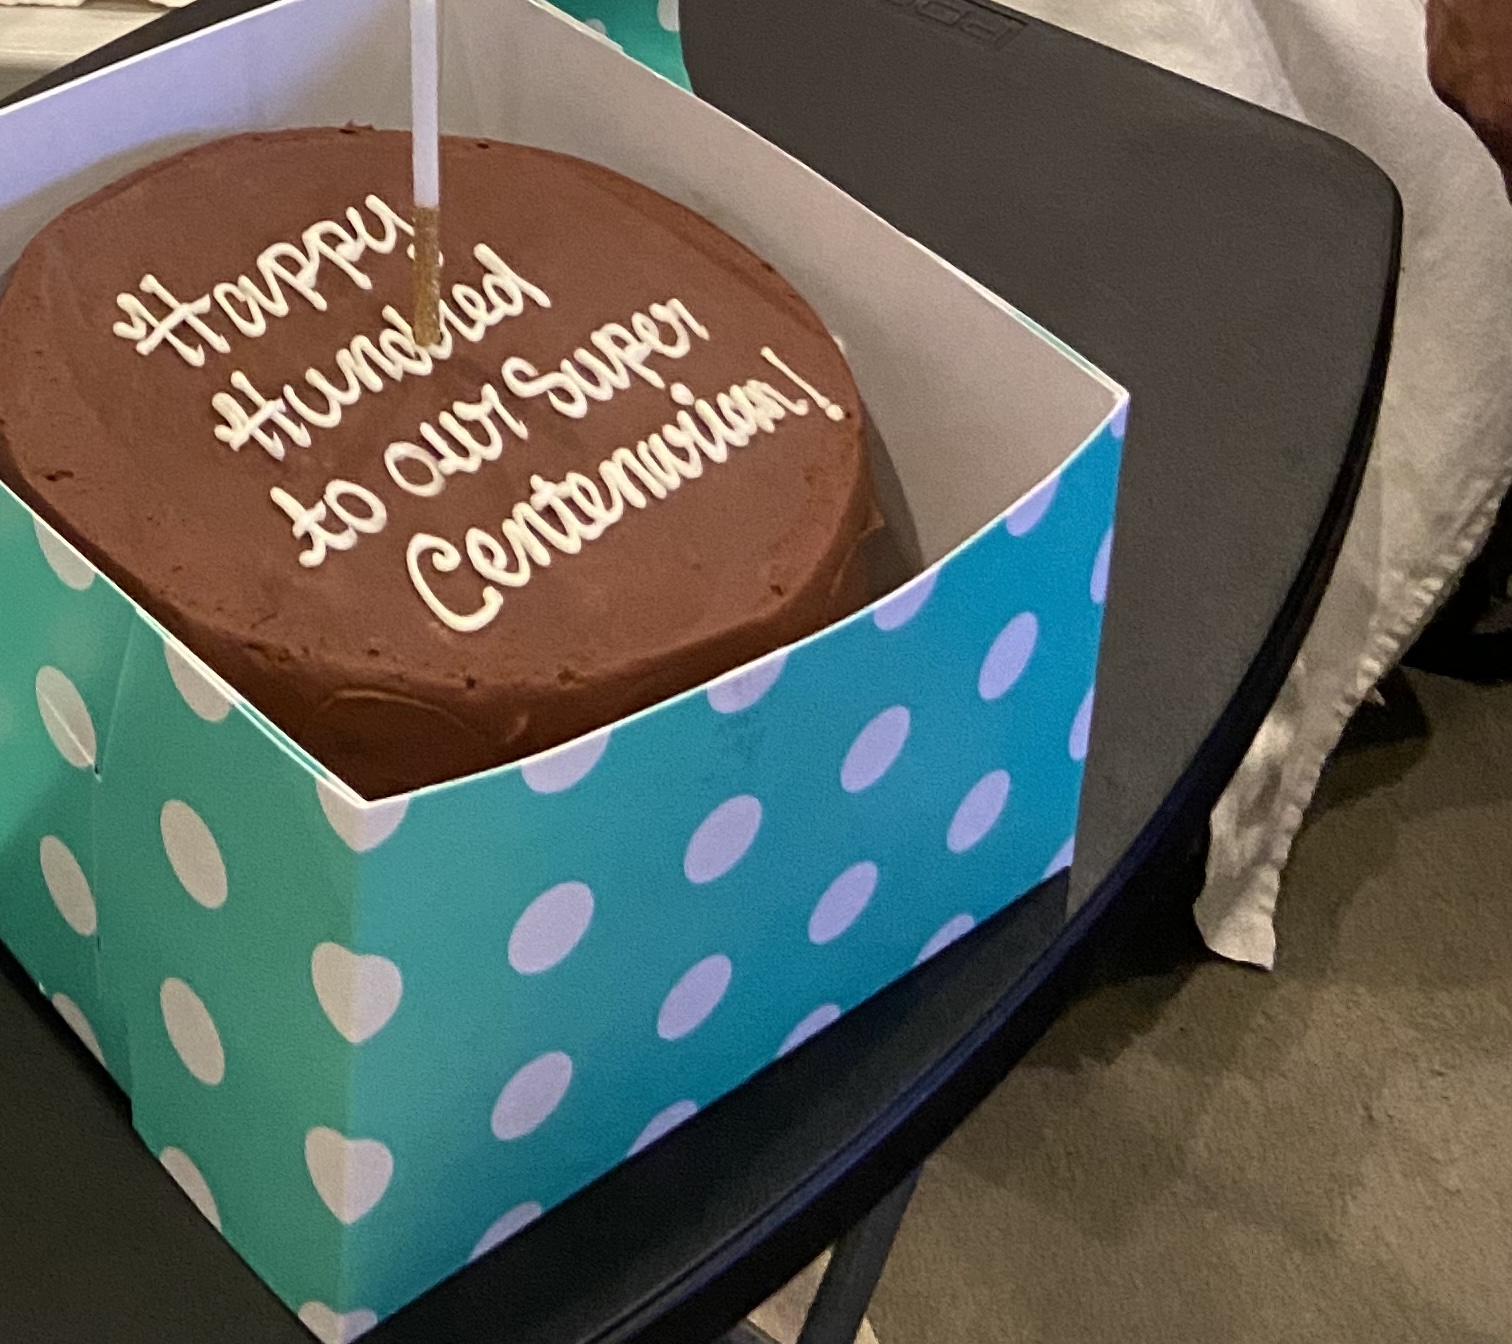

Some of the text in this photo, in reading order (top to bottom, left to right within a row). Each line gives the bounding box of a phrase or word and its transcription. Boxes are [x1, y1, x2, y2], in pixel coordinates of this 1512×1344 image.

[113, 194, 444, 367] Happy
[211, 242, 552, 461] Hundred
[270, 297, 710, 568] to our Super
